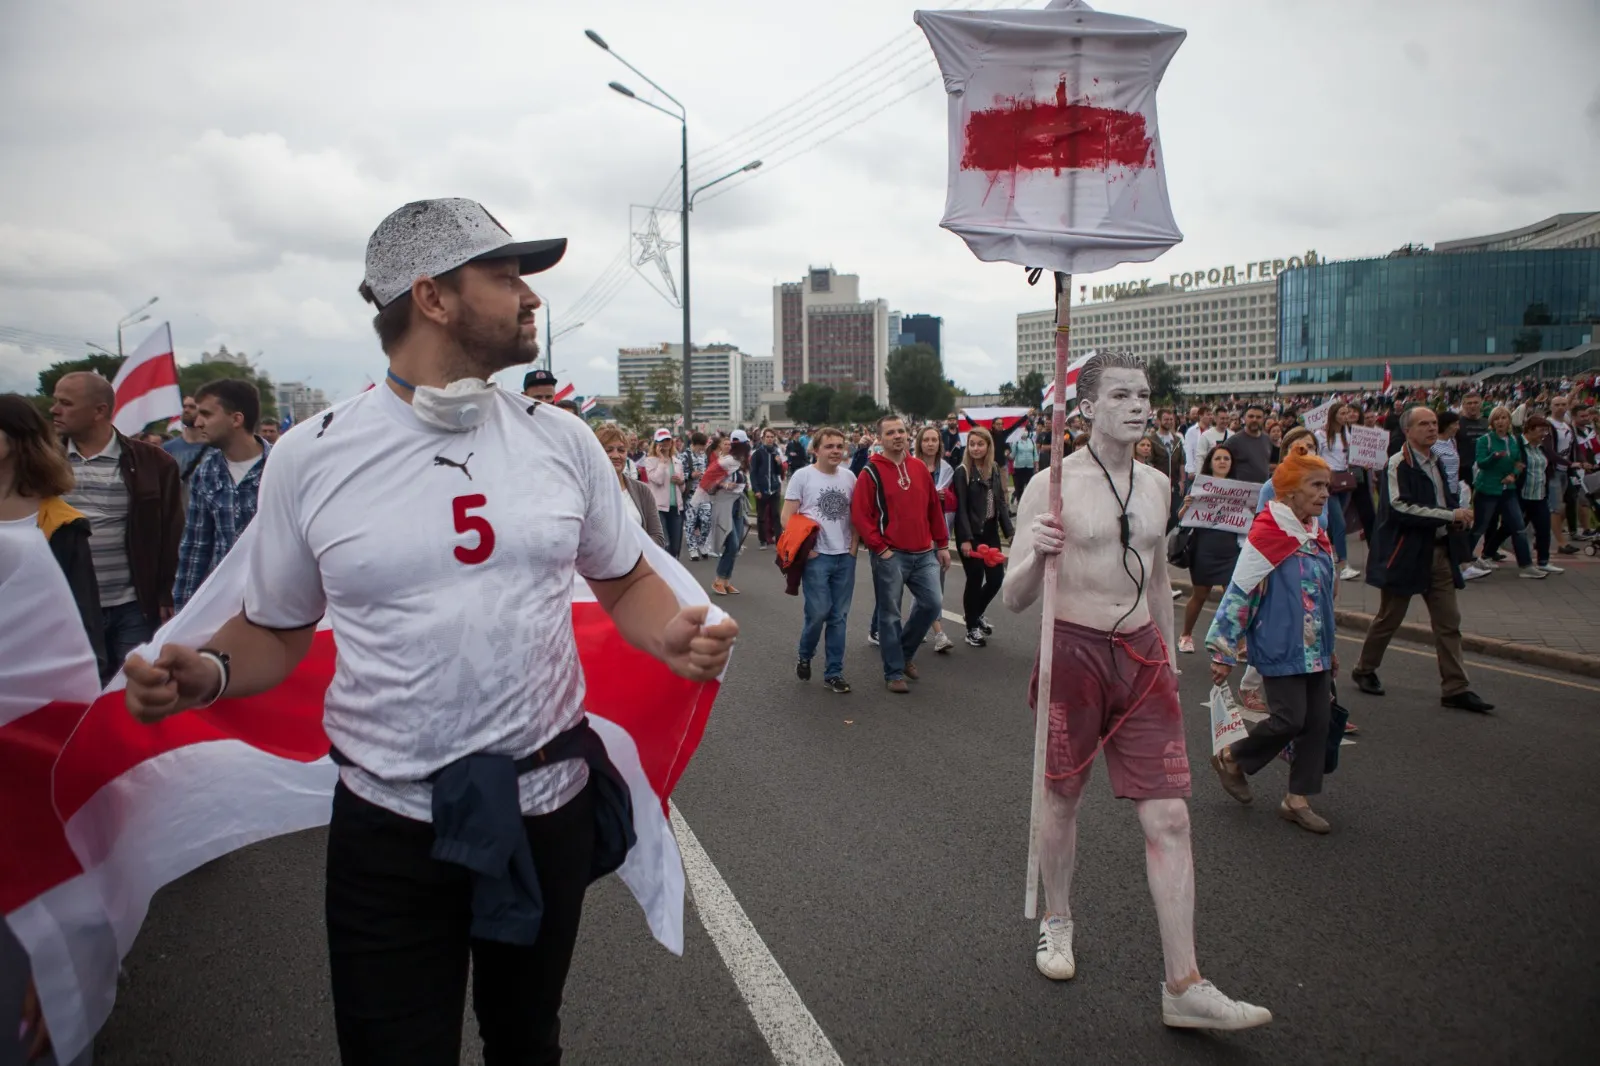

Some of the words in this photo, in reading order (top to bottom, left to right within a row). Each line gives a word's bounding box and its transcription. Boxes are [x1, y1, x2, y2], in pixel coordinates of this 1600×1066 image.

[1092, 278, 1151, 301] МИНСК
[1169, 249, 1318, 290] ГОРОД-ГЕРОЙ
[452, 493, 496, 565] 5
